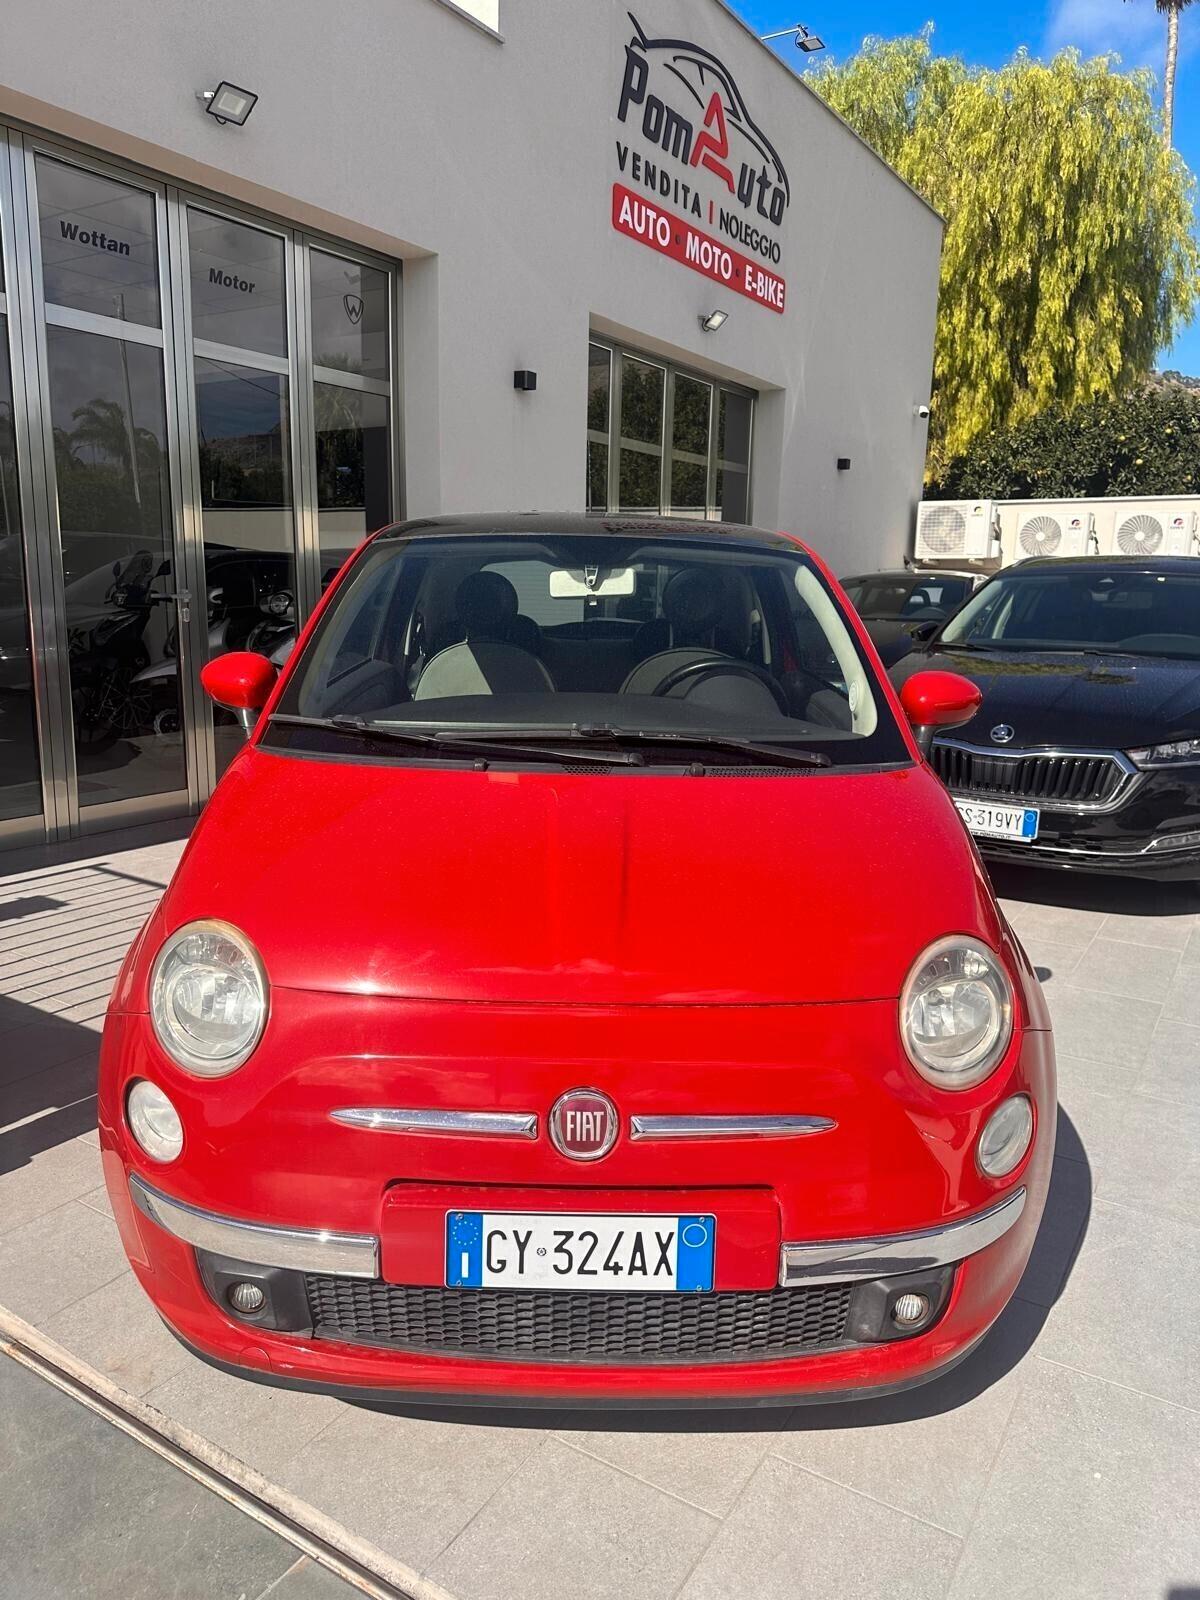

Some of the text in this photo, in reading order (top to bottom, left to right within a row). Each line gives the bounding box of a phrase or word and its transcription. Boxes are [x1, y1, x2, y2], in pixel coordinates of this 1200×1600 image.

[616, 141, 781, 264] VENDITA NOLEGGIO
[60, 220, 130, 256] Wottan
[619, 196, 784, 308] AUTO MOTO E-BIKE
[208, 267, 256, 293] Motor
[567, 1111, 604, 1142] FIAT
[552, 1231, 675, 1276] 324AX
